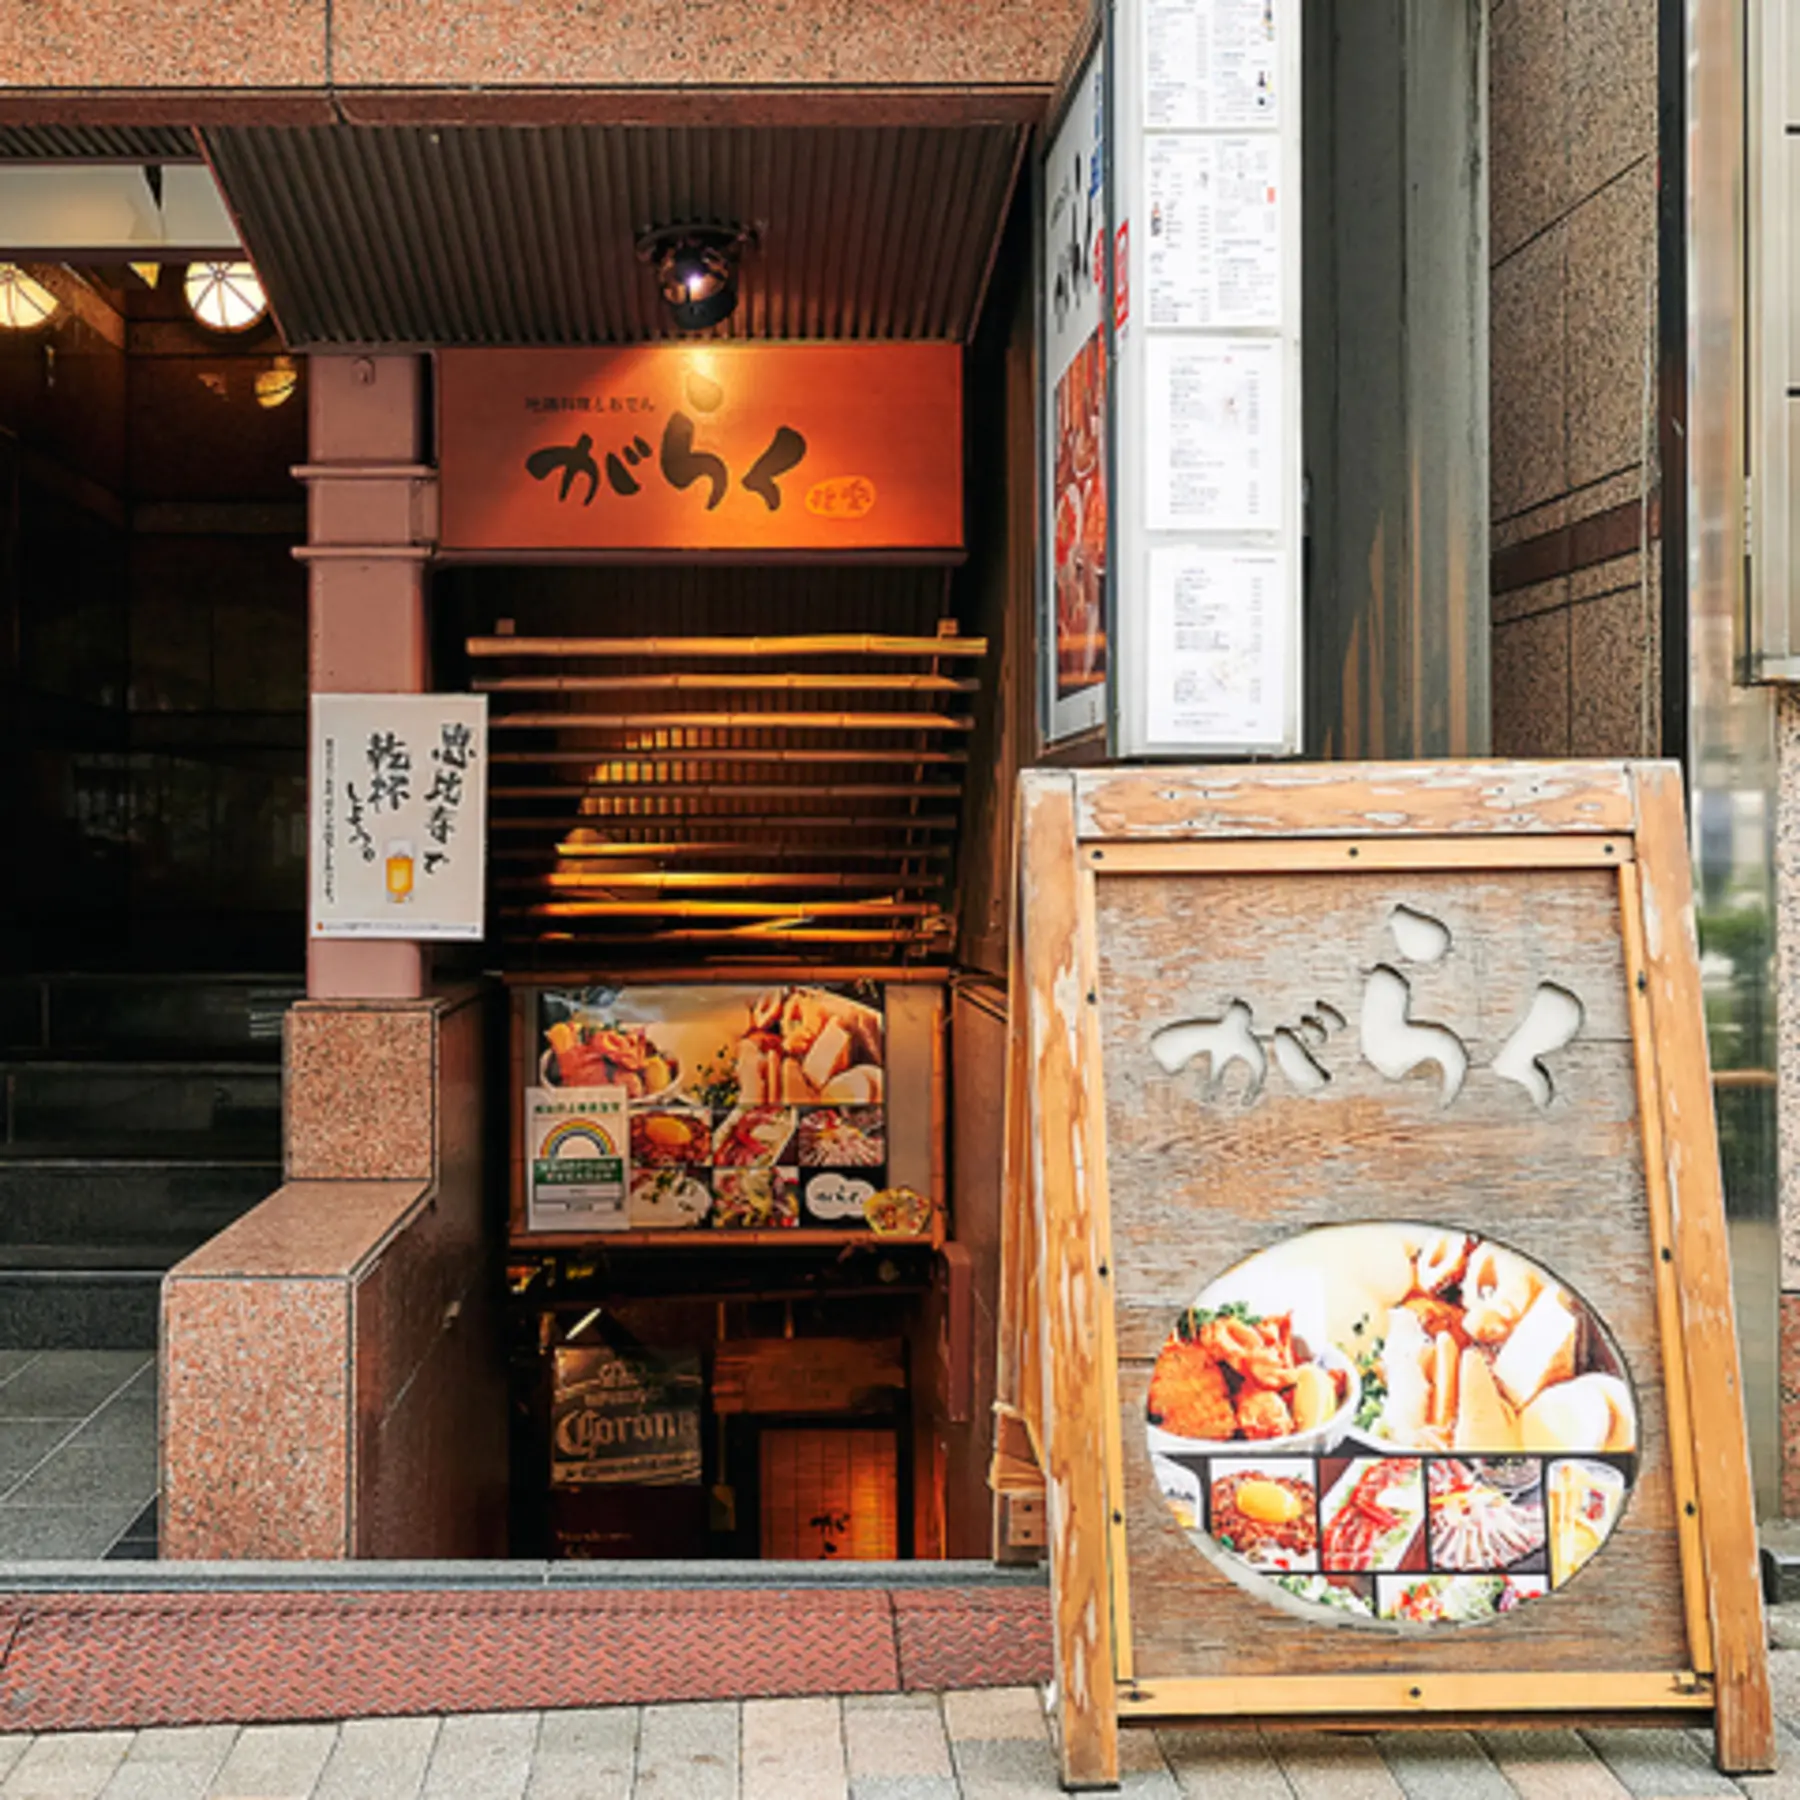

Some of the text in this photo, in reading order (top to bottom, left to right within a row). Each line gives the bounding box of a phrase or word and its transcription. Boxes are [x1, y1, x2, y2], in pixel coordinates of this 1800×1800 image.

[526, 374, 807, 511] がらく
[367, 732, 411, 814] 乾杯
[1150, 902, 1585, 1110] がらく
